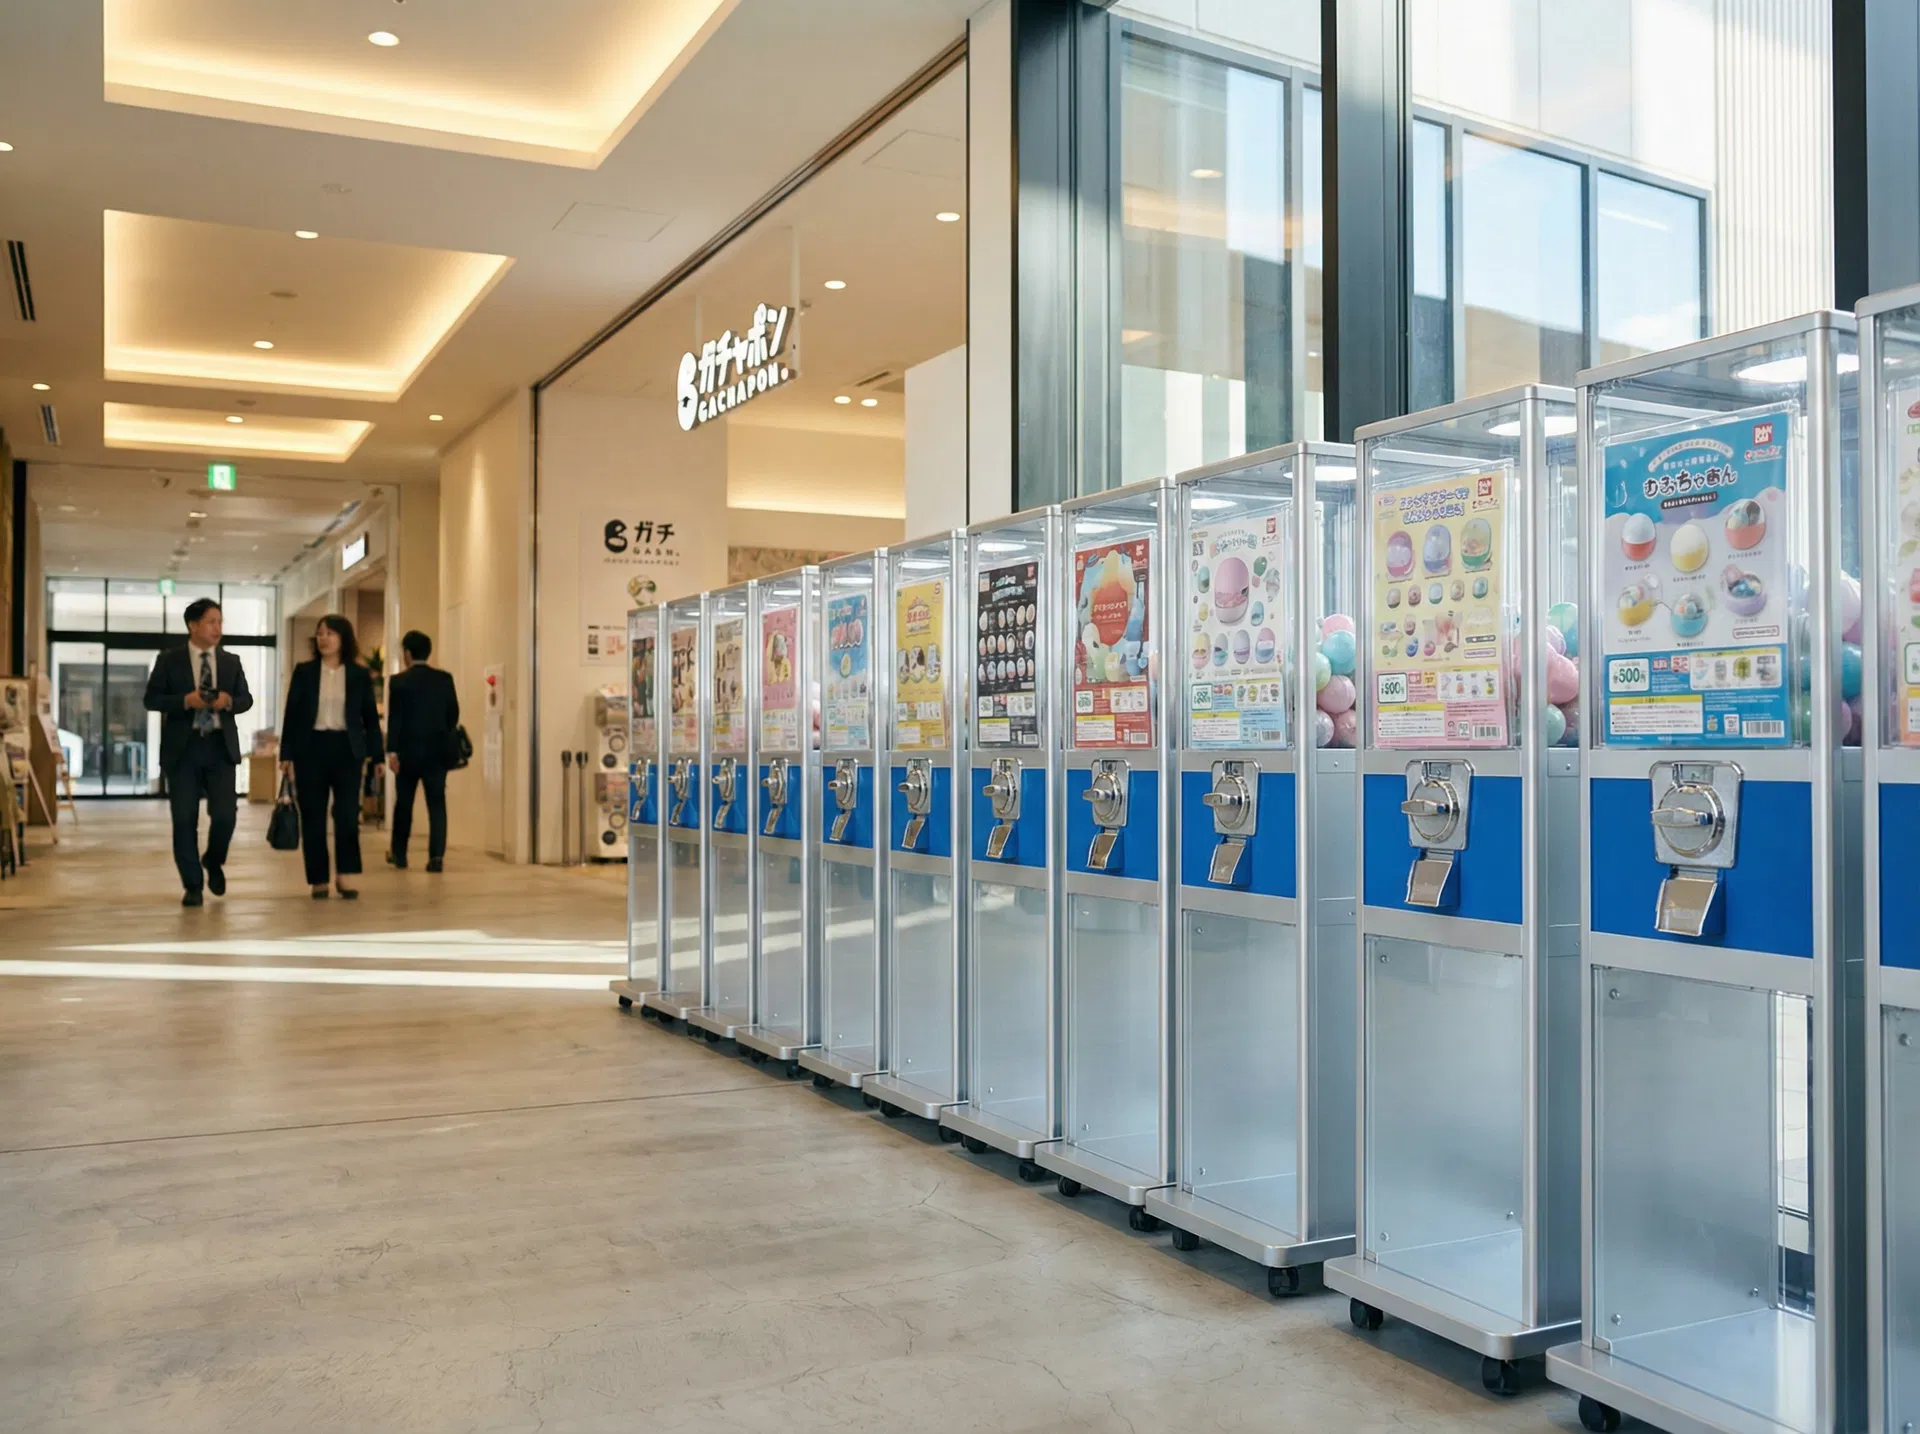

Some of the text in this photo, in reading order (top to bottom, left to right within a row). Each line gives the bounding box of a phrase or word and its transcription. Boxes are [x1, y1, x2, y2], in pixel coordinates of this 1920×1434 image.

[698, 303, 788, 394] ガチャポン
[634, 521, 675, 545] ガチ
